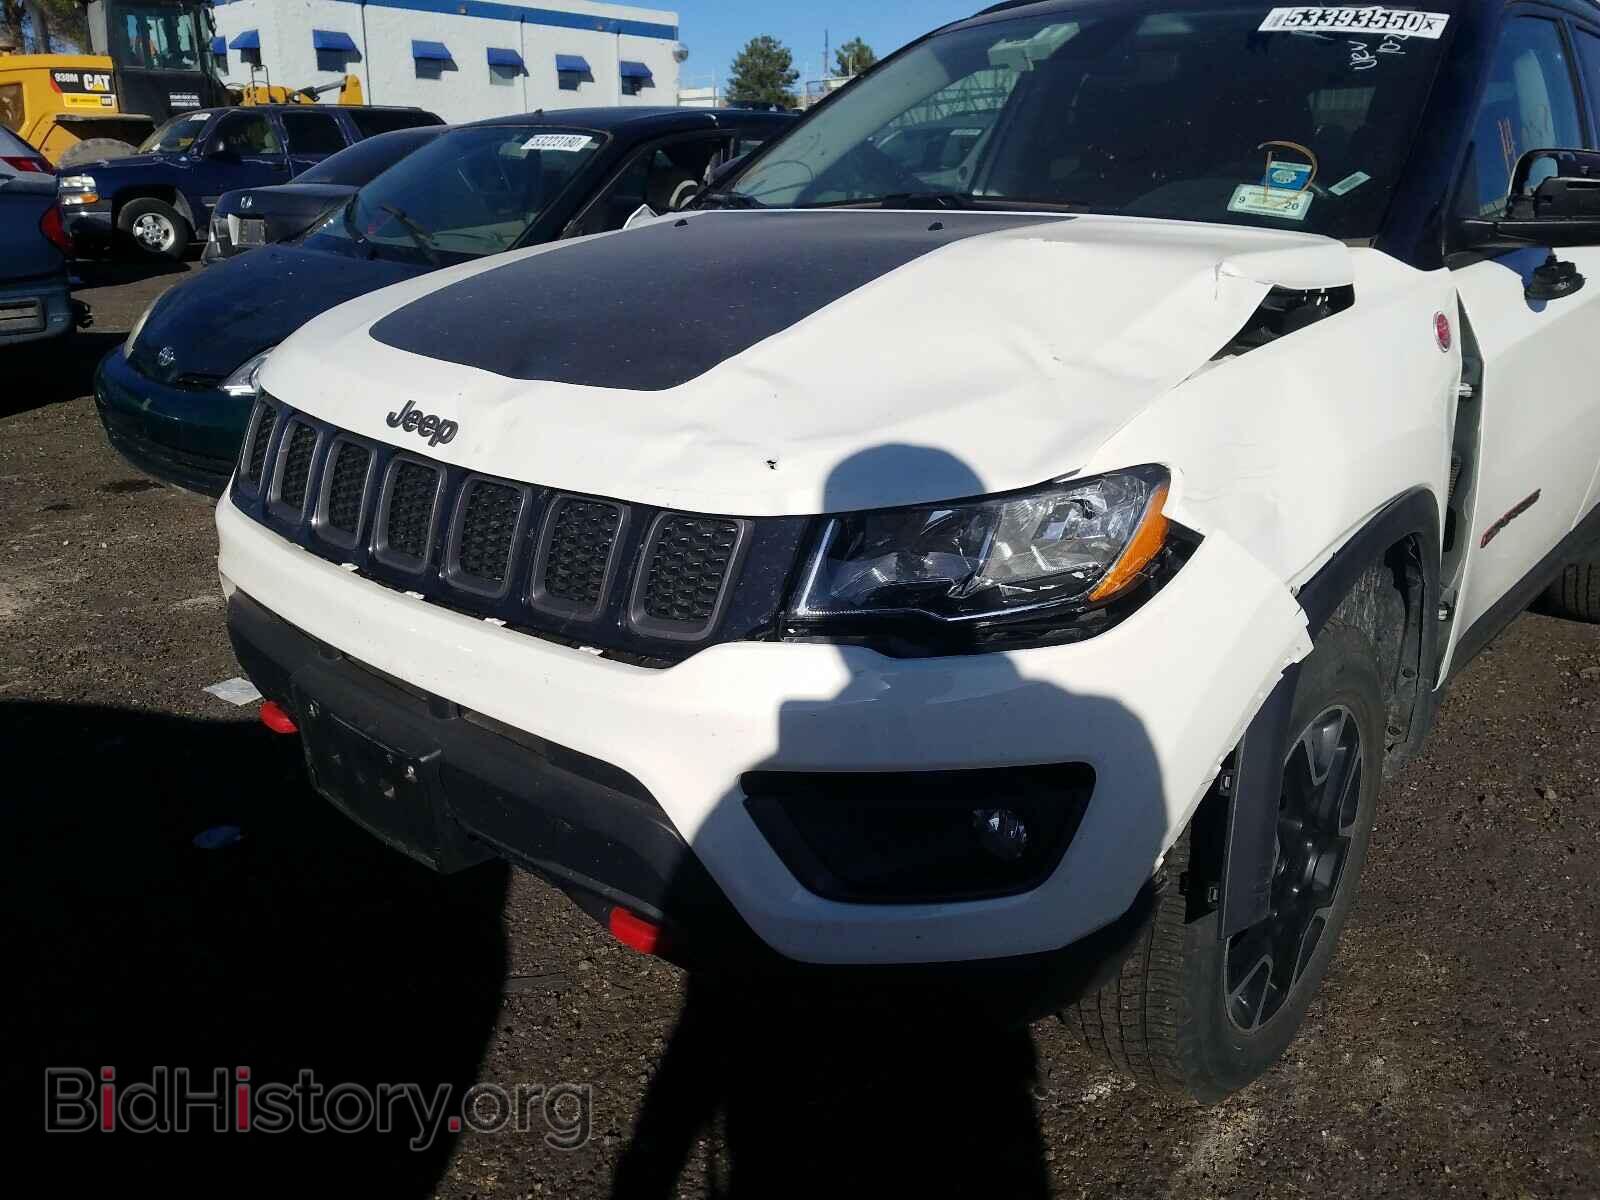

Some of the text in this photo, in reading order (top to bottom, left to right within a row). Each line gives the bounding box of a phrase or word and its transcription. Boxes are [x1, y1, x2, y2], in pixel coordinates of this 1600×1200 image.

[1284, 8, 1424, 32] 53393550
[83, 74, 111, 91] CAT
[1284, 201, 1300, 211] 20
[386, 399, 459, 448] Jeep
